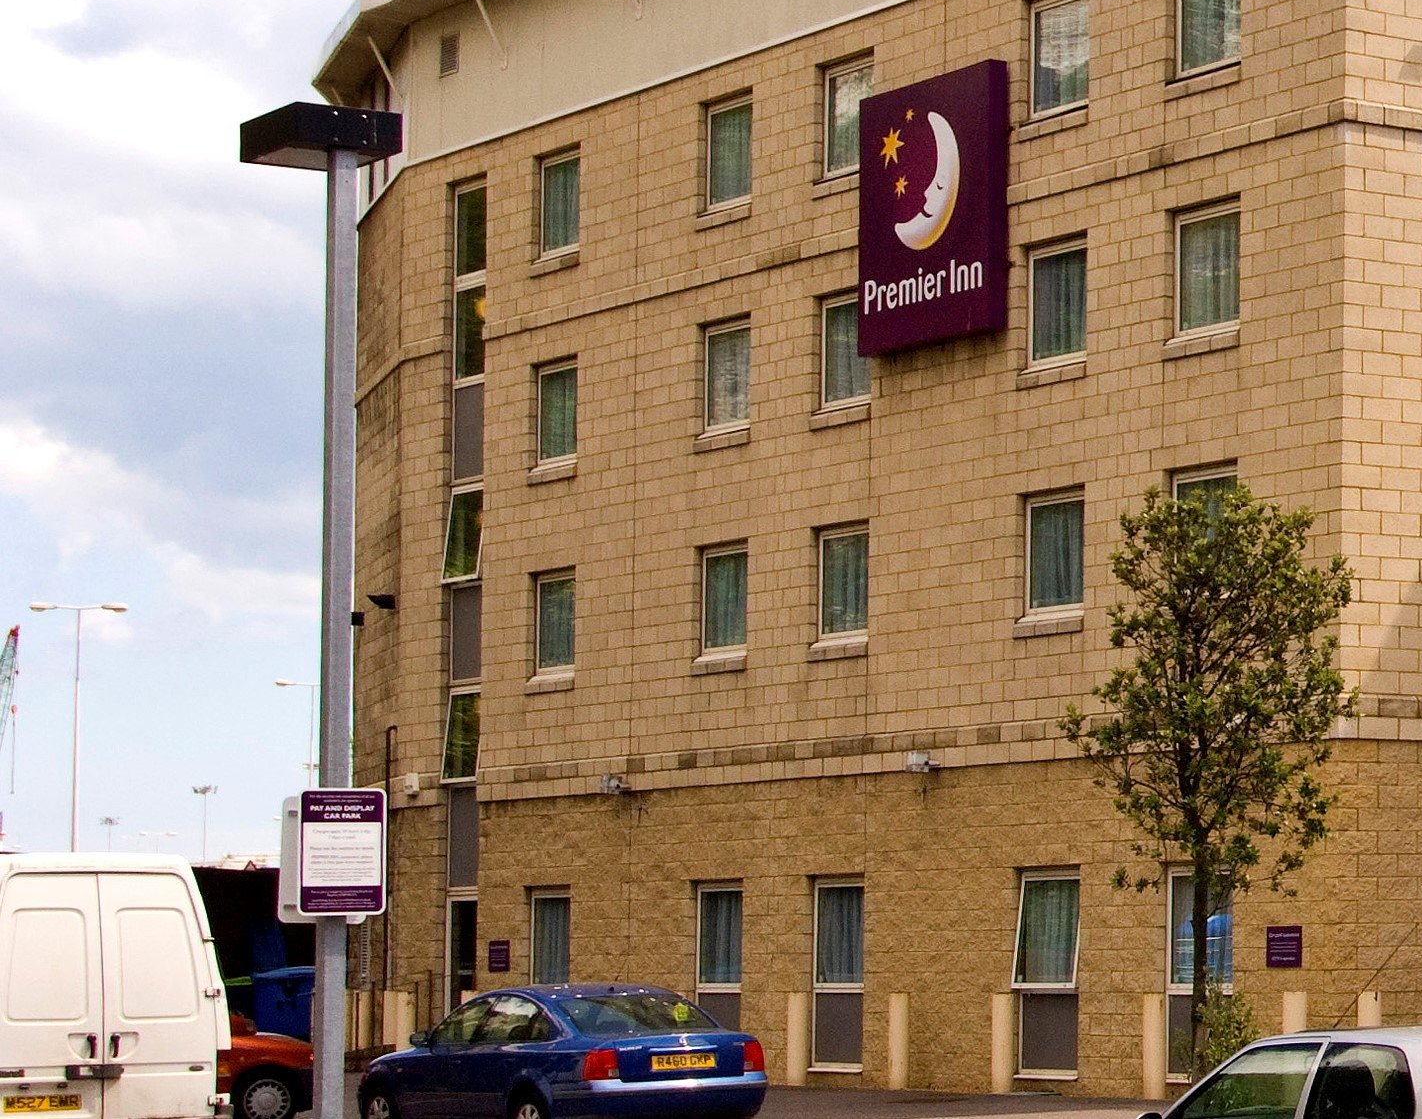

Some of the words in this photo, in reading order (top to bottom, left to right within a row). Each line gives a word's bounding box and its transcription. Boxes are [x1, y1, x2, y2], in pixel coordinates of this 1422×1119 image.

[864, 267, 947, 315] Premier
[949, 259, 983, 294] Inn
[5, 1095, 46, 1109] M527
